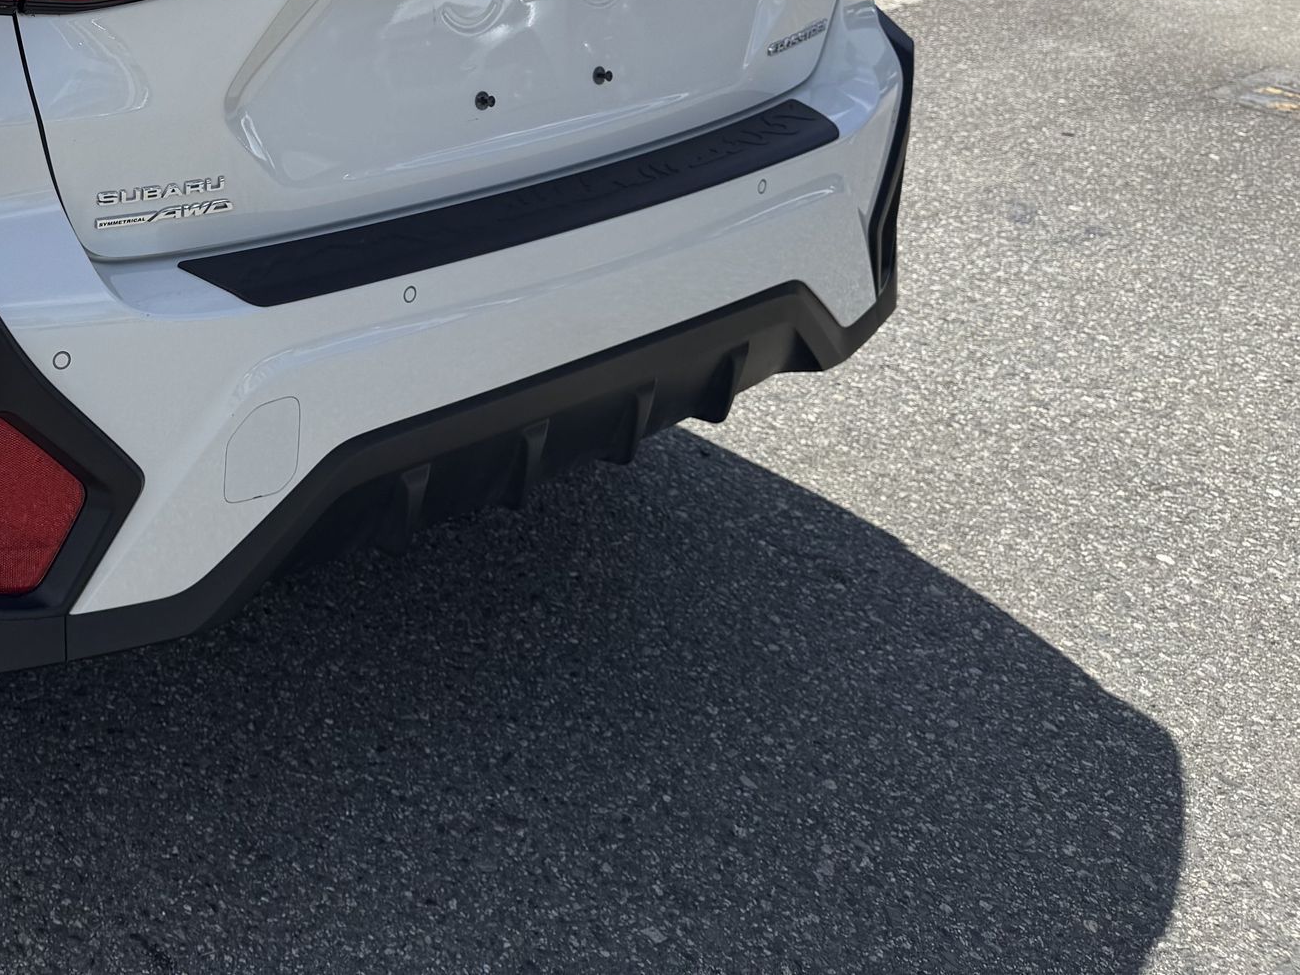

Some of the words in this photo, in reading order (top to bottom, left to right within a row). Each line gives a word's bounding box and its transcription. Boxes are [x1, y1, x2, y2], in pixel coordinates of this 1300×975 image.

[97, 175, 225, 207] SUBARU
[99, 217, 146, 227] SYMMETRICAL
[148, 199, 233, 223] AWD
